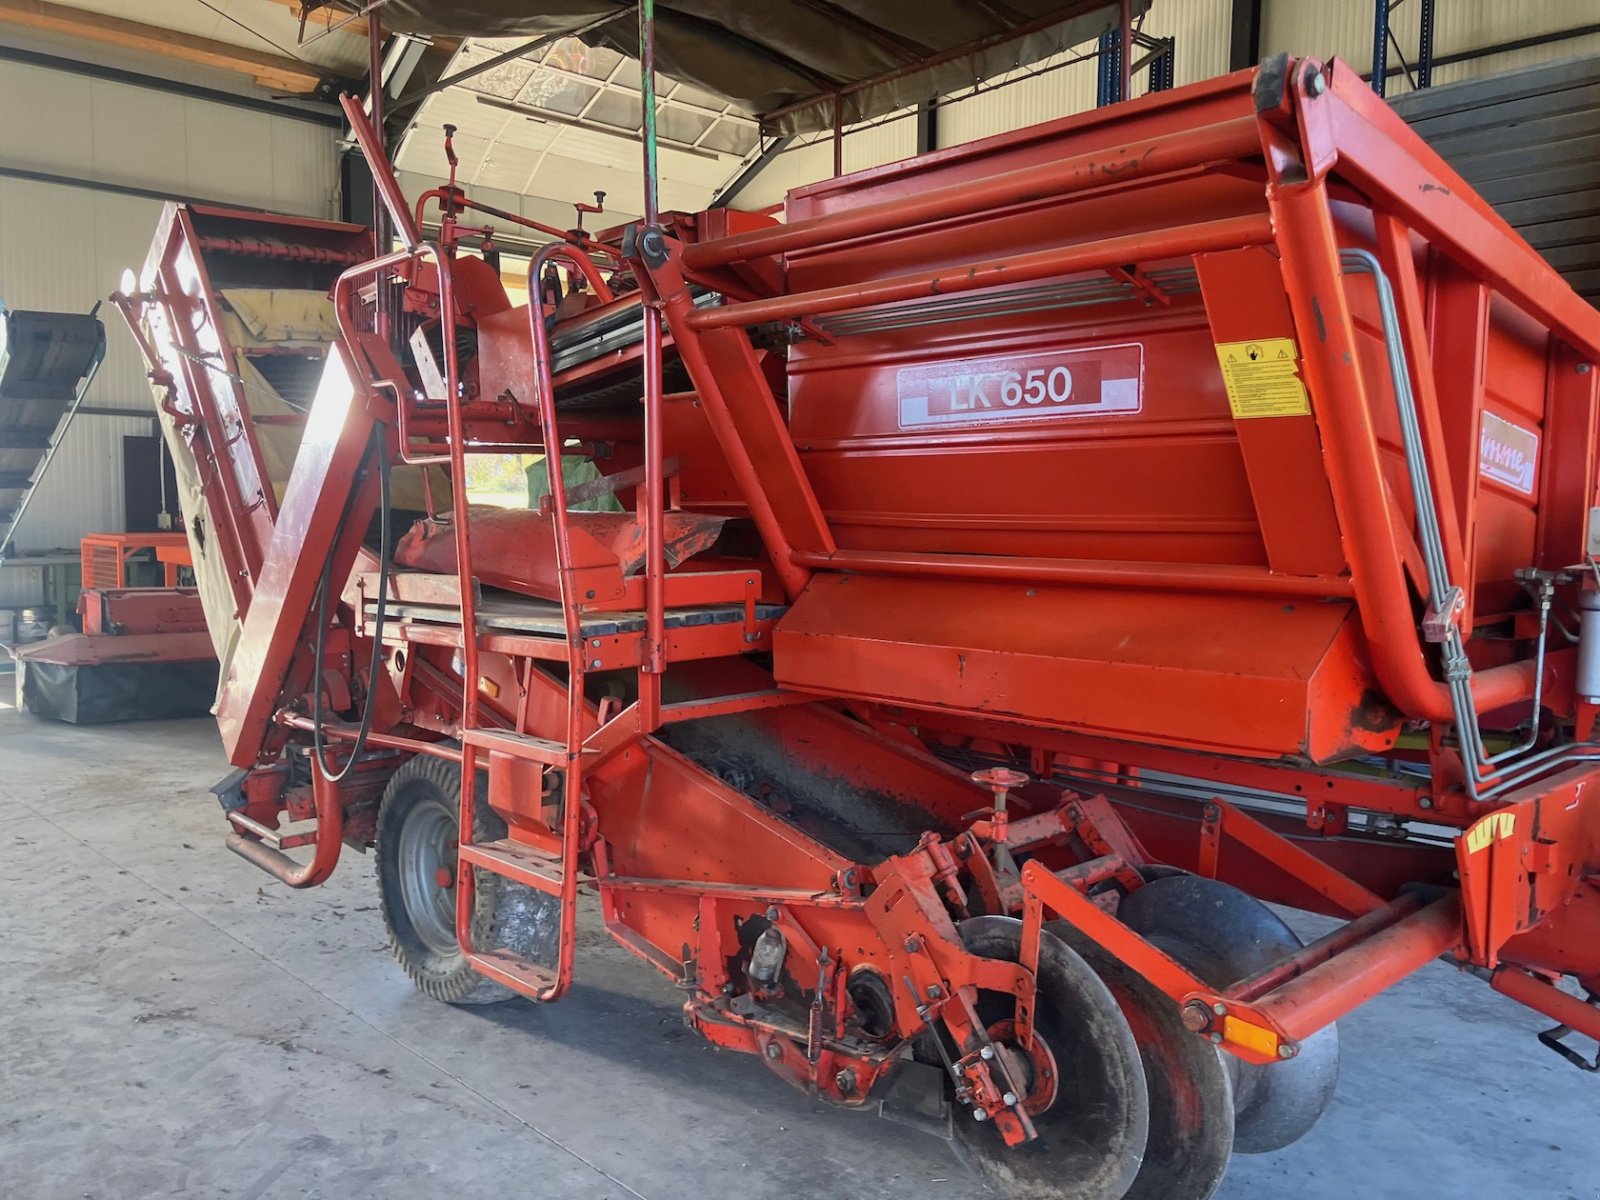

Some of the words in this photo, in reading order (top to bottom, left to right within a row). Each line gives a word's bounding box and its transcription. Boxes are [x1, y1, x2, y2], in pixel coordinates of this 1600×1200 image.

[949, 375, 992, 411] LK
[1000, 366, 1073, 407] 650
[1482, 428, 1526, 474] imme
